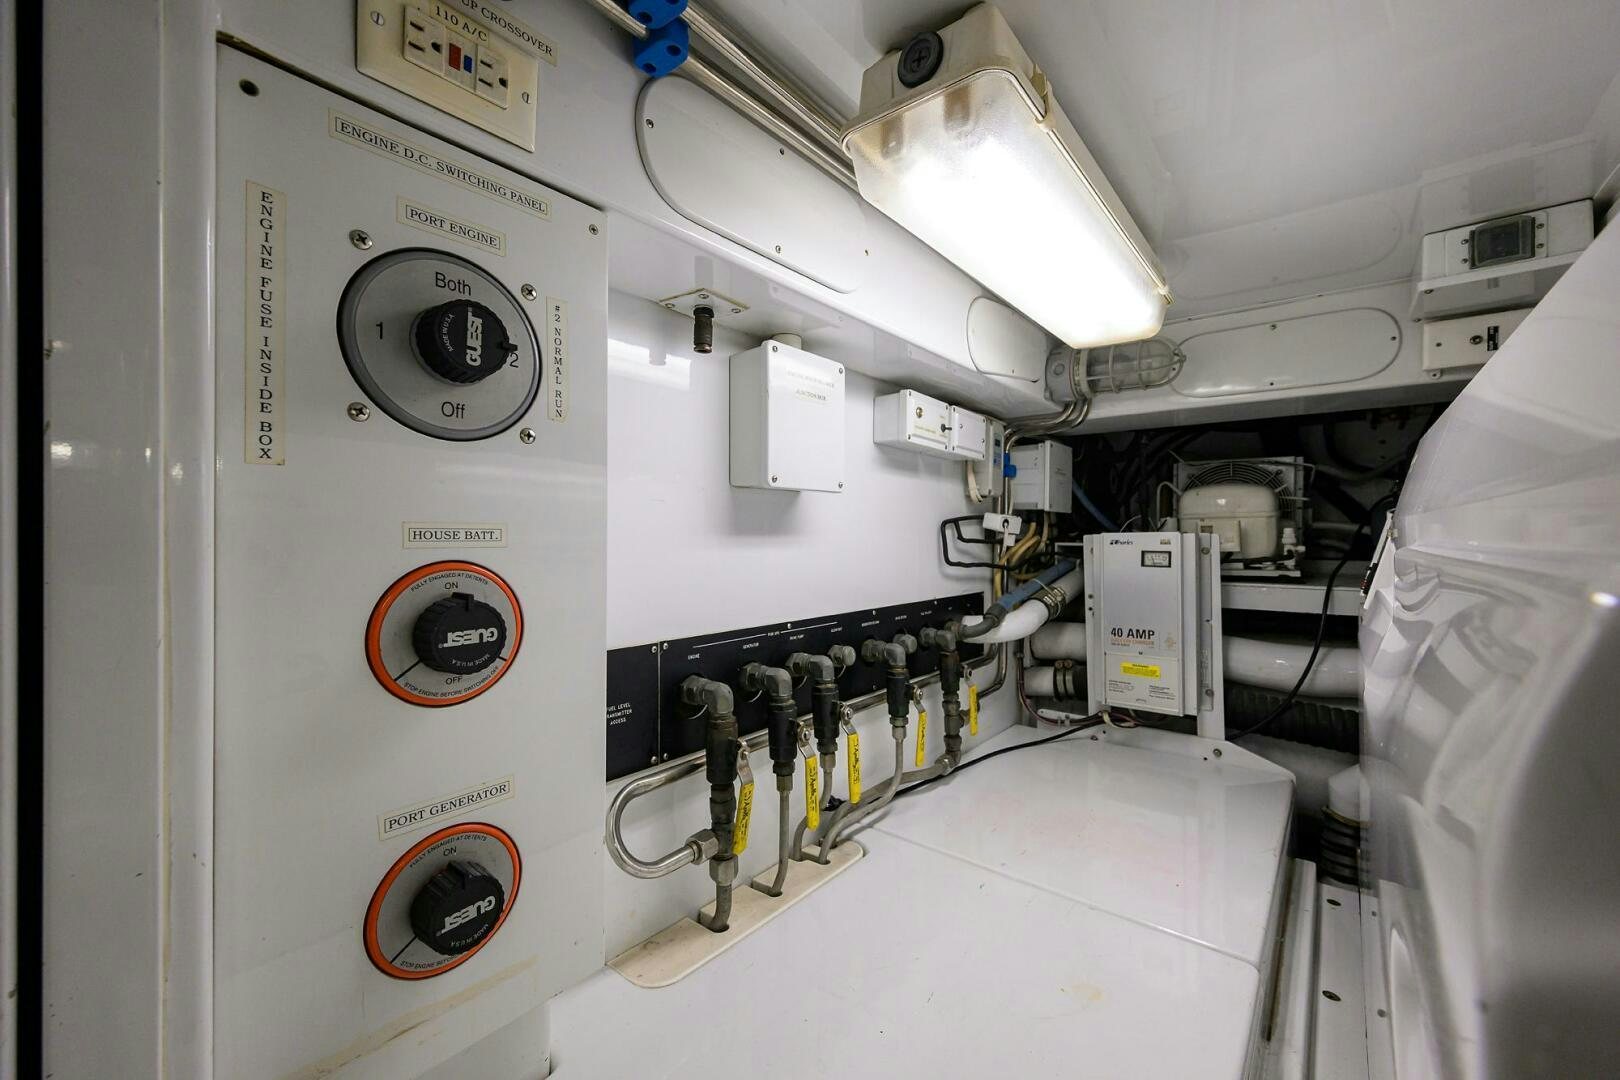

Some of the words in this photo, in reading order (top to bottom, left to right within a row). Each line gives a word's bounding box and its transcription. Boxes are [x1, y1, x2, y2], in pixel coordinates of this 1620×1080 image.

[436, 6, 459, 25] 110
[462, 22, 487, 41] A/C
[481, 7, 552, 56] CROSSOVER
[341, 121, 400, 154] ENGINE
[404, 148, 432, 167] D.C.
[436, 161, 507, 197] SWITCHING
[510, 191, 545, 213] PANEL
[259, 191, 273, 270] ENGINE
[409, 208, 446, 228] PORT
[449, 222, 498, 247] ENGINE
[435, 271, 472, 296] Both
[259, 276, 273, 329] FUSE
[376, 321, 384, 339] 1
[465, 311, 482, 367] GUEST
[510, 352, 519, 369] 2
[554, 327, 563, 385] NORMAL
[259, 336, 273, 414] INSIDE
[440, 401, 466, 420] Off
[555, 389, 563, 418] RUN
[258, 421, 273, 459] BOX
[412, 530, 461, 541] HOUSE
[464, 530, 499, 541] BATT.
[411, 579, 428, 592] FULLY
[444, 582, 459, 590] ON
[443, 627, 498, 648] GUEST
[1110, 627, 1123, 638] 40
[1126, 627, 1155, 640] AMP
[445, 676, 464, 685] OFF
[388, 809, 426, 830] PORT
[429, 783, 508, 815] GENERATOR
[443, 846, 457, 857] ON
[441, 895, 496, 934] GUEST
